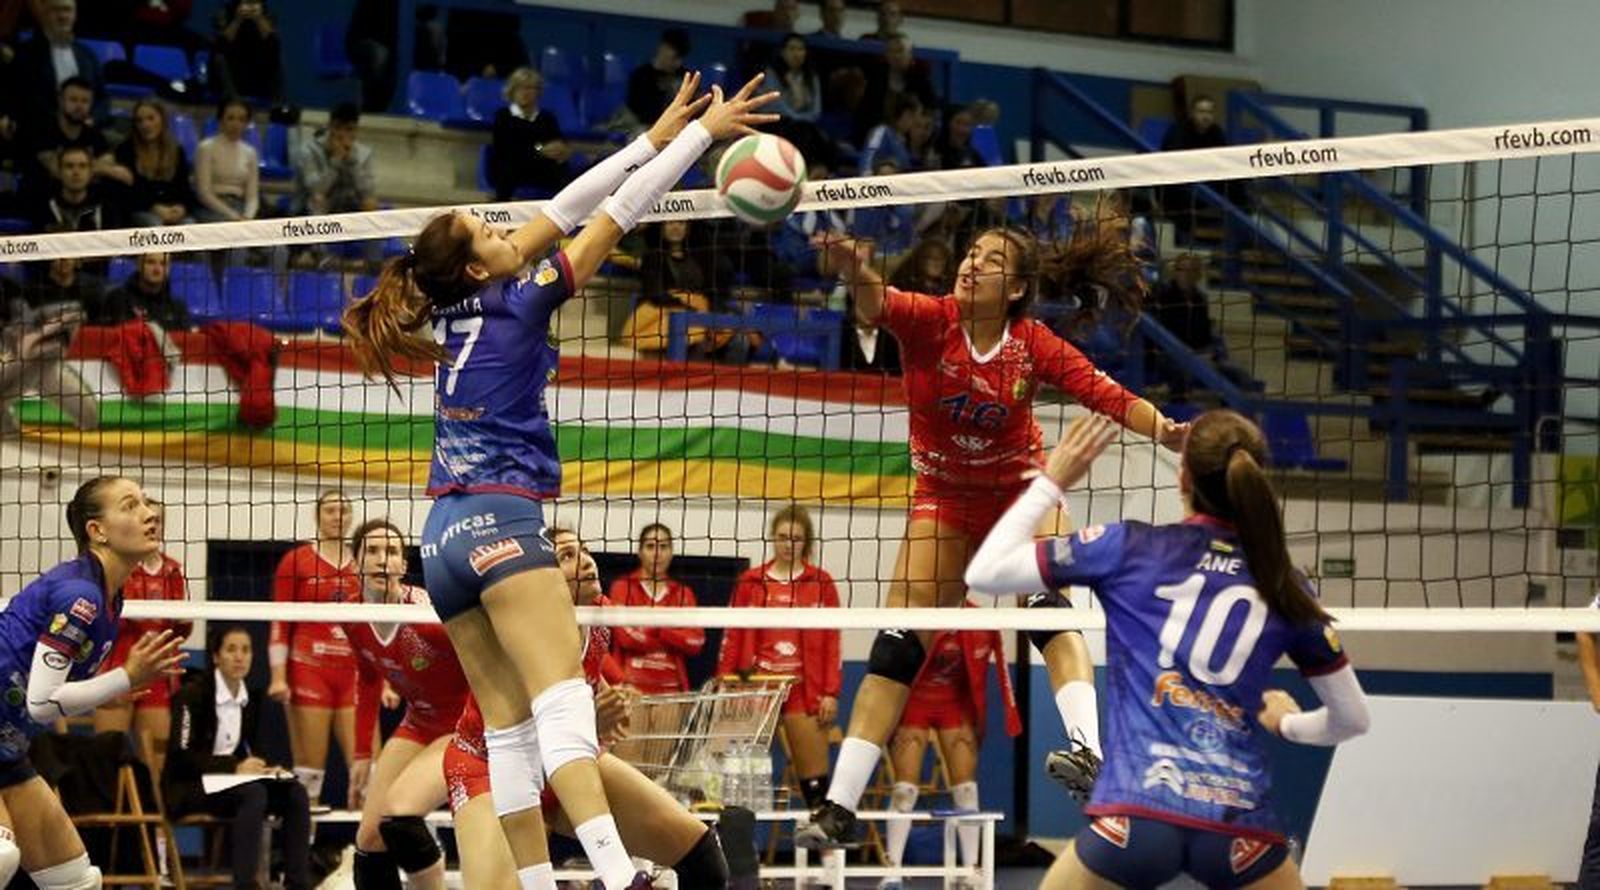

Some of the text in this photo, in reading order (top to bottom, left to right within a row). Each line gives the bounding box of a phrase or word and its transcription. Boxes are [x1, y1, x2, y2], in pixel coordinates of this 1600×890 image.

[1494, 127, 1592, 149] rfevb.com
[1249, 146, 1338, 168] rfevb.com
[1022, 164, 1105, 187] rfevb.com
[815, 183, 893, 203] rfevb.com
[129, 230, 185, 248] rfevb.com
[282, 220, 343, 238] rfevb.com
[938, 394, 1008, 432] 16
[1196, 552, 1243, 575] ANE
[1155, 574, 1269, 686] 10
